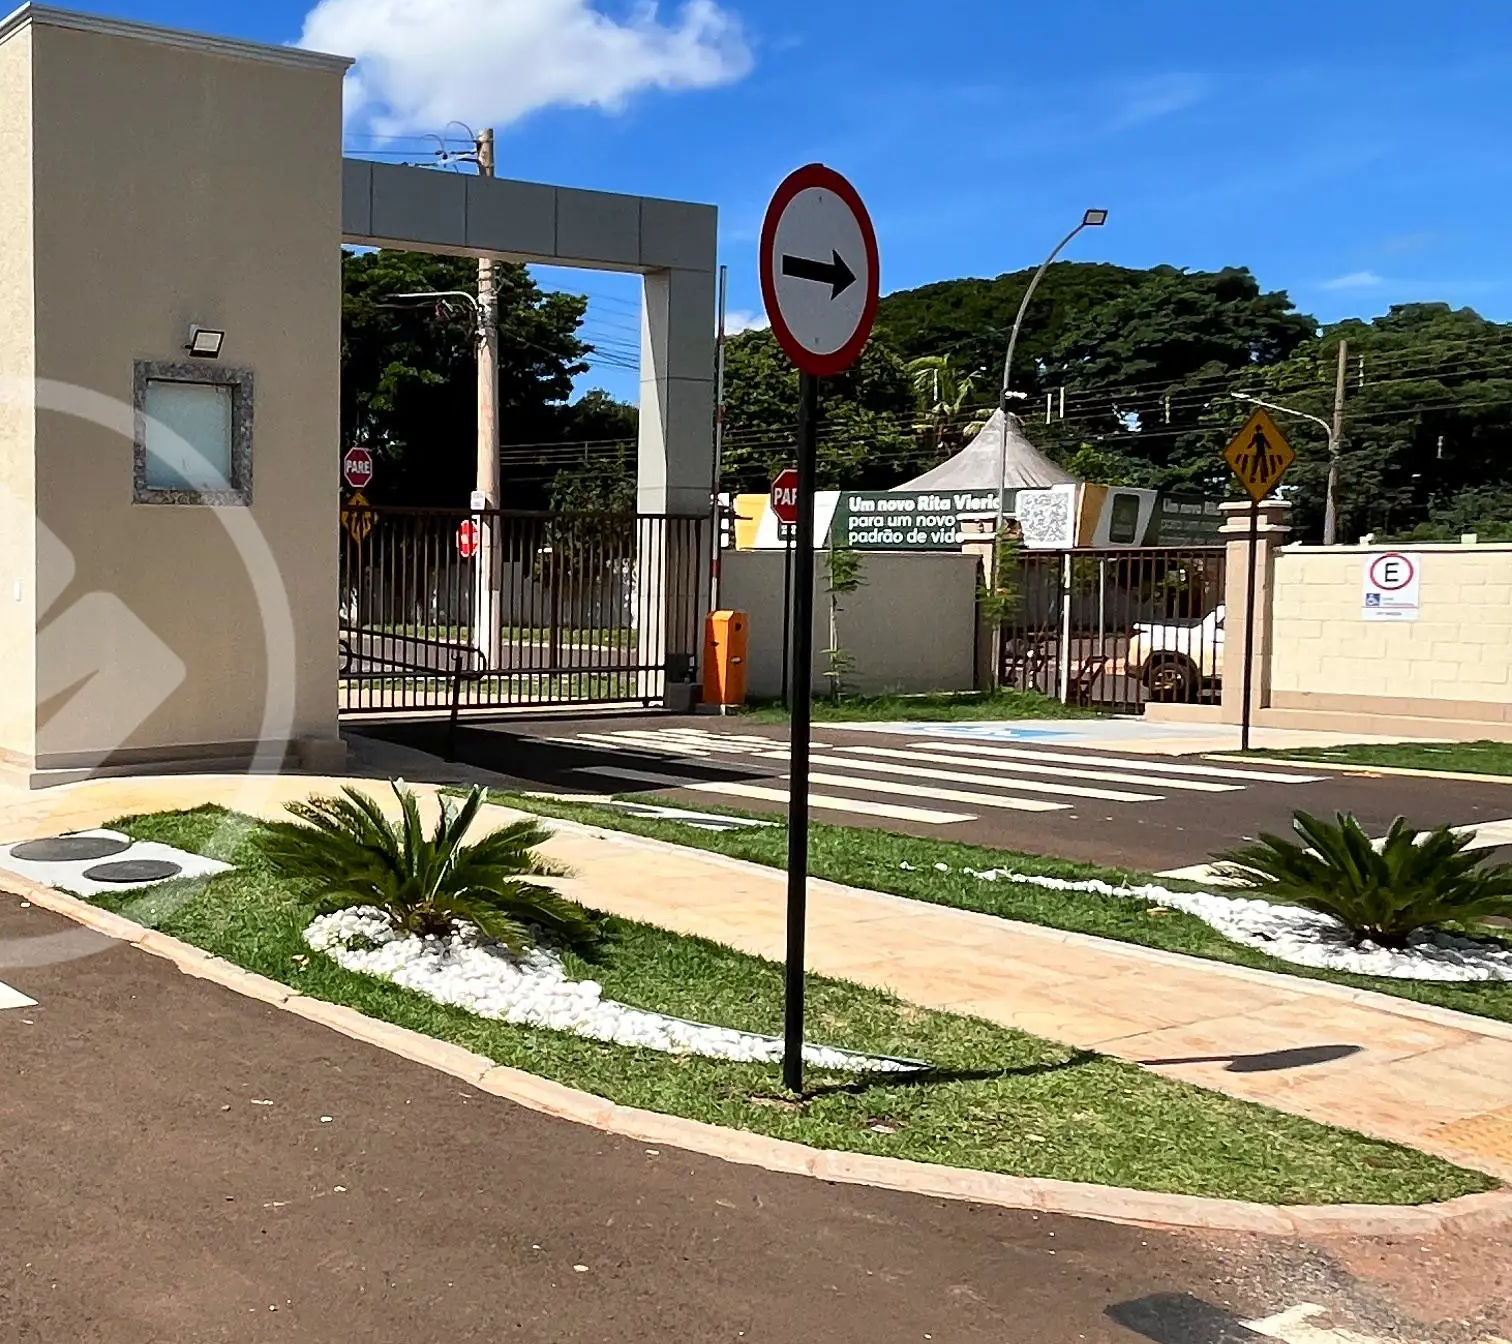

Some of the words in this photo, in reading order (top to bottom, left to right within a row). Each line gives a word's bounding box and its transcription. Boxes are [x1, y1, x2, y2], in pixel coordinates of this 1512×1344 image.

[346, 460, 370, 474] PARE
[774, 488, 797, 505] PAR
[848, 497, 875, 512] Um
[877, 500, 915, 511] novo
[917, 495, 951, 512] Rita
[848, 515, 884, 530] para
[887, 515, 912, 527] um
[916, 515, 955, 527] novo
[848, 528, 903, 546] padrão
[906, 528, 928, 543] de
[1385, 562, 1399, 582] E
